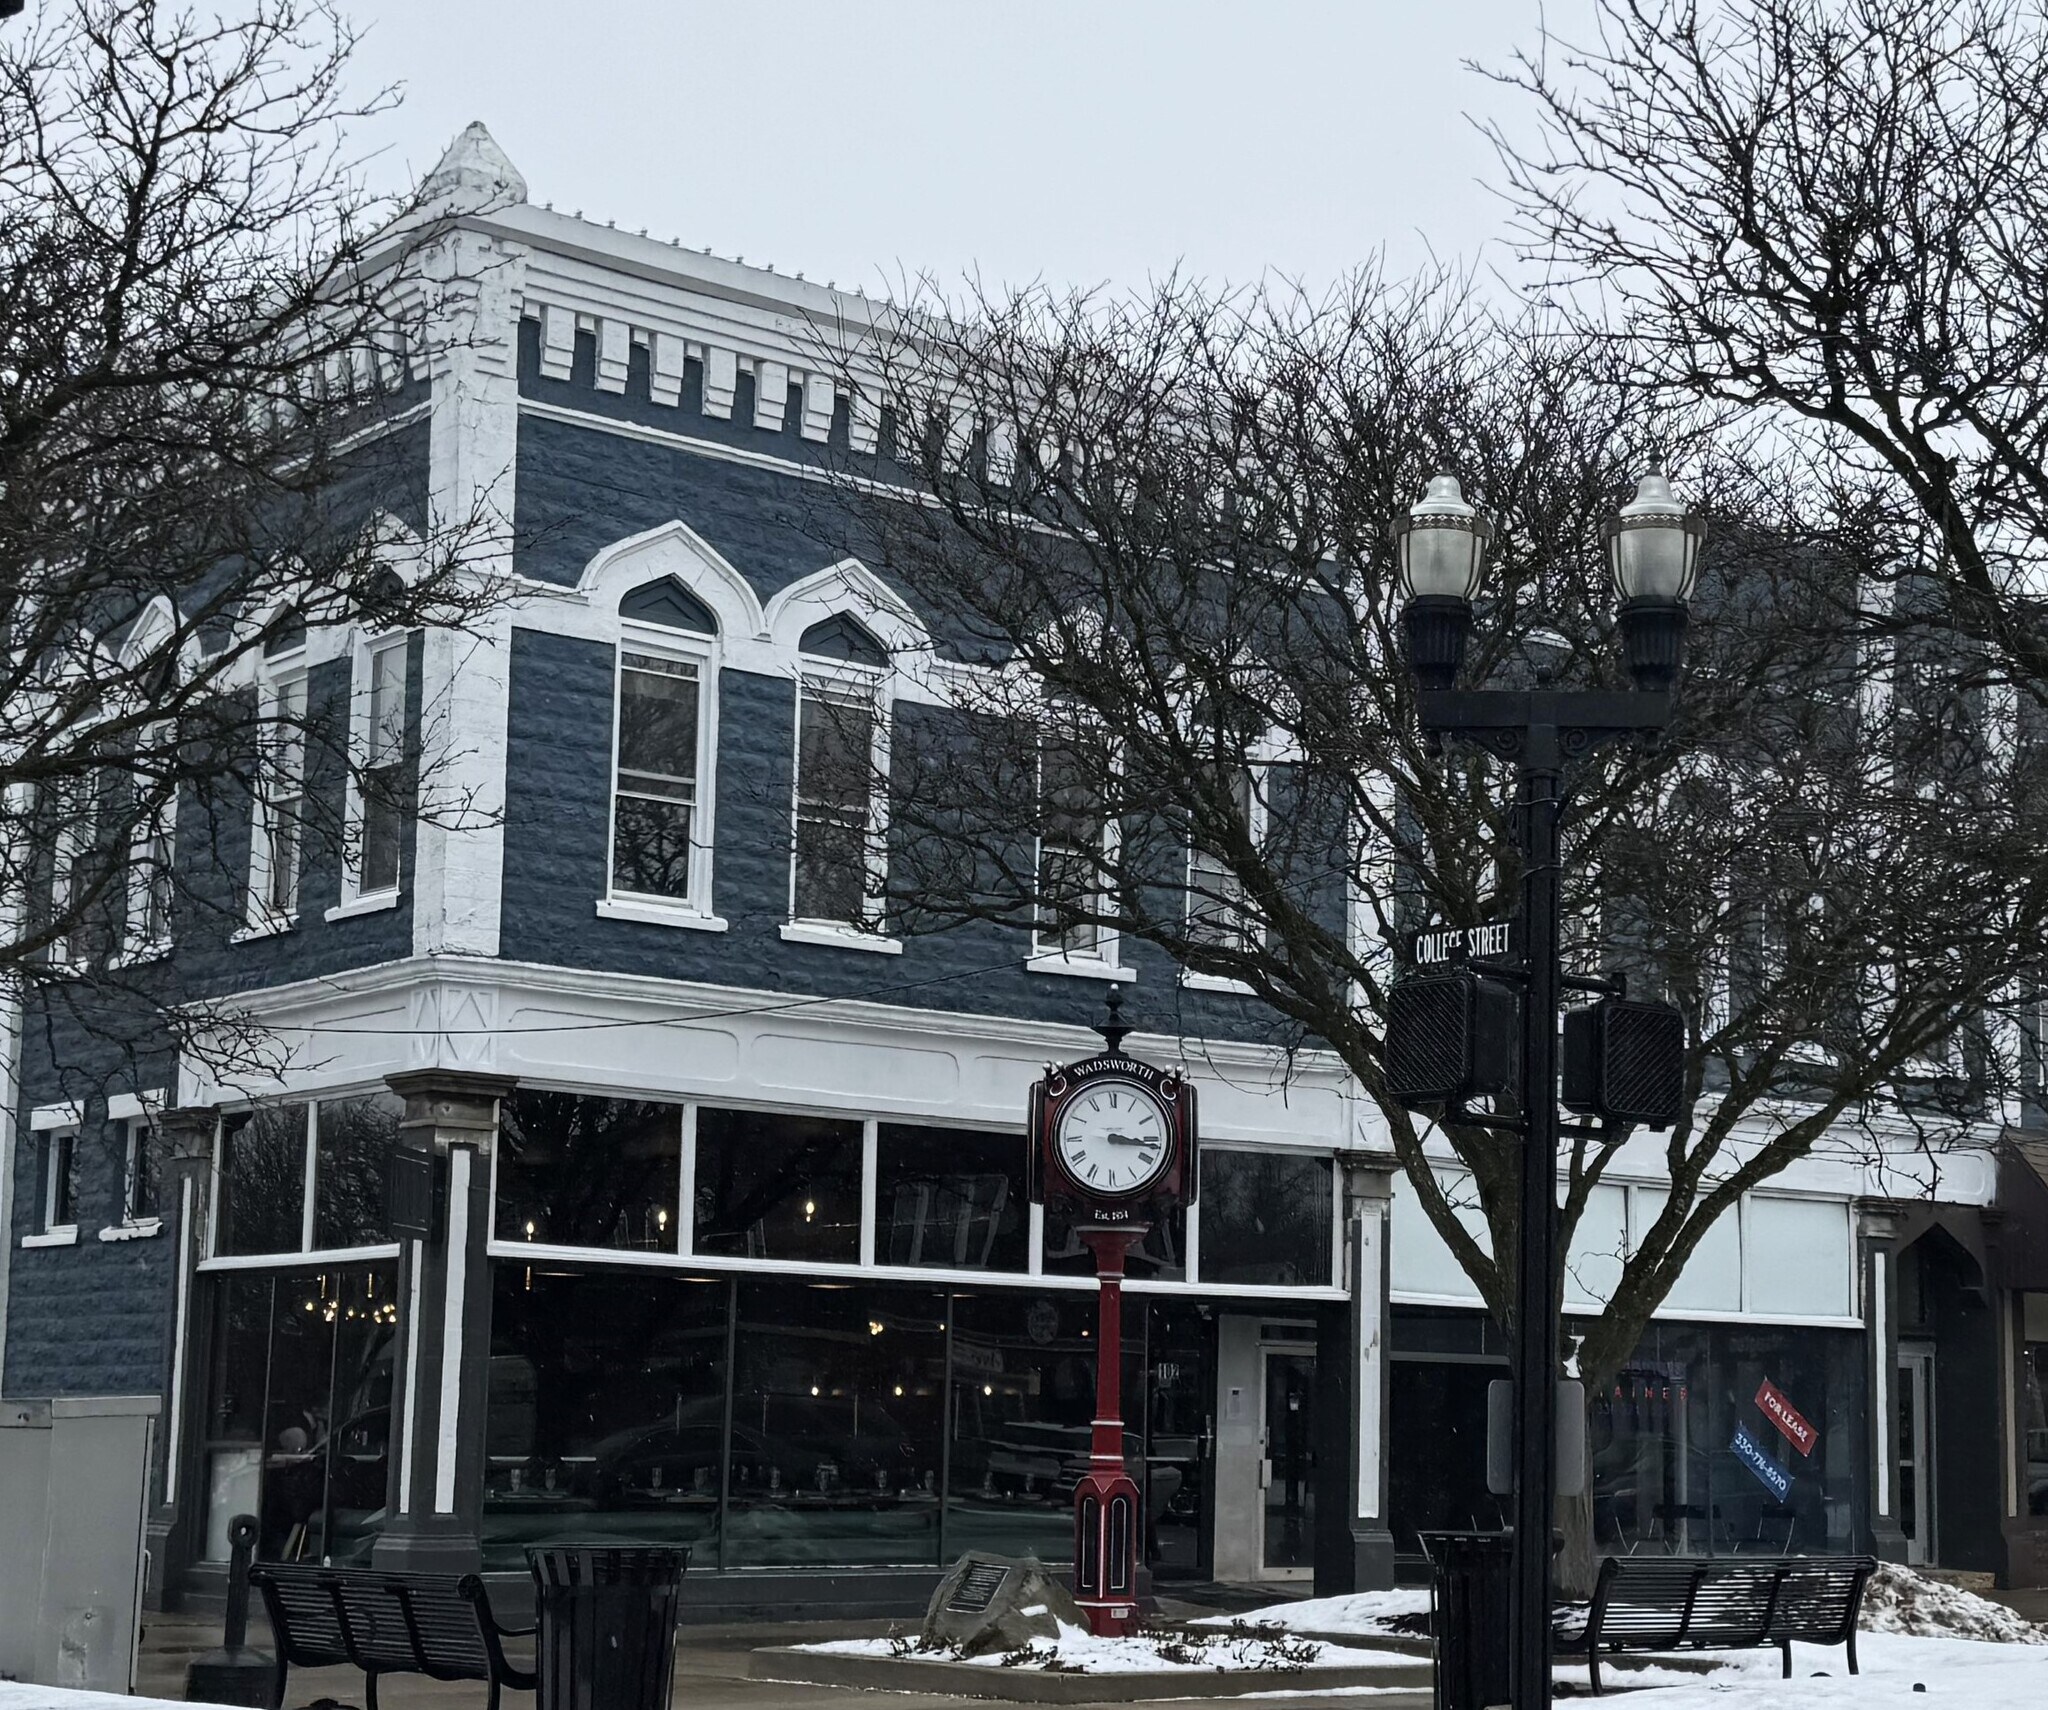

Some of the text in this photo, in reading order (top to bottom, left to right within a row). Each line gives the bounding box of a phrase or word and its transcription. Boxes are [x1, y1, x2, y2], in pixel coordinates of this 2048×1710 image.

[1468, 923, 1510, 957] STREET
[1074, 1060, 1154, 1080] WADSWORTH
[1764, 1391, 1808, 1443] FOR LEASE
